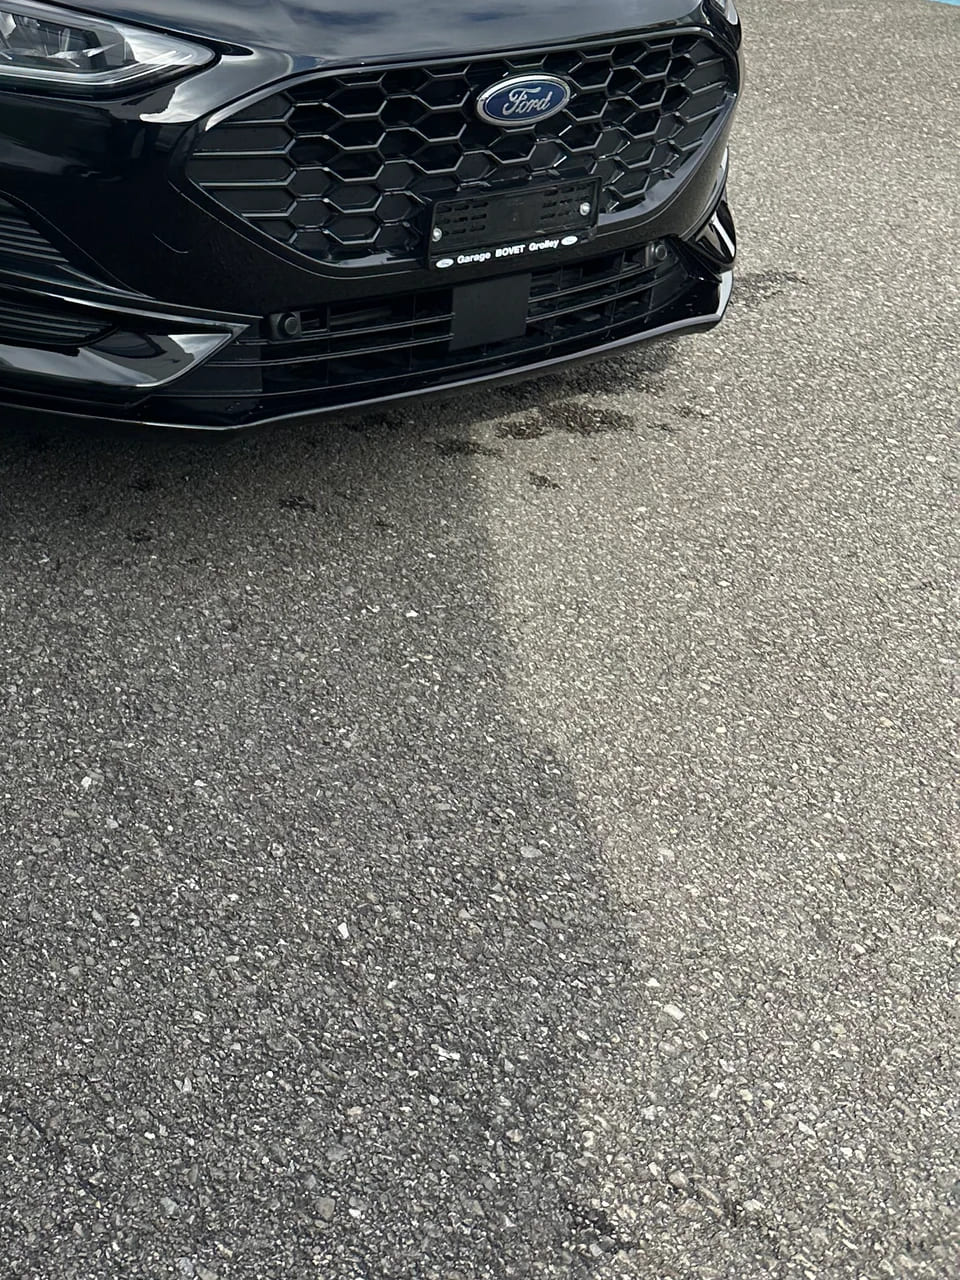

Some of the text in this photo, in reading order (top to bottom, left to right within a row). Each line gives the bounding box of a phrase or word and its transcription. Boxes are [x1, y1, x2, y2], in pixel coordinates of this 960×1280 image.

[502, 87, 553, 116] Ford
[457, 252, 491, 265] Garage
[495, 245, 526, 258] BOVET
